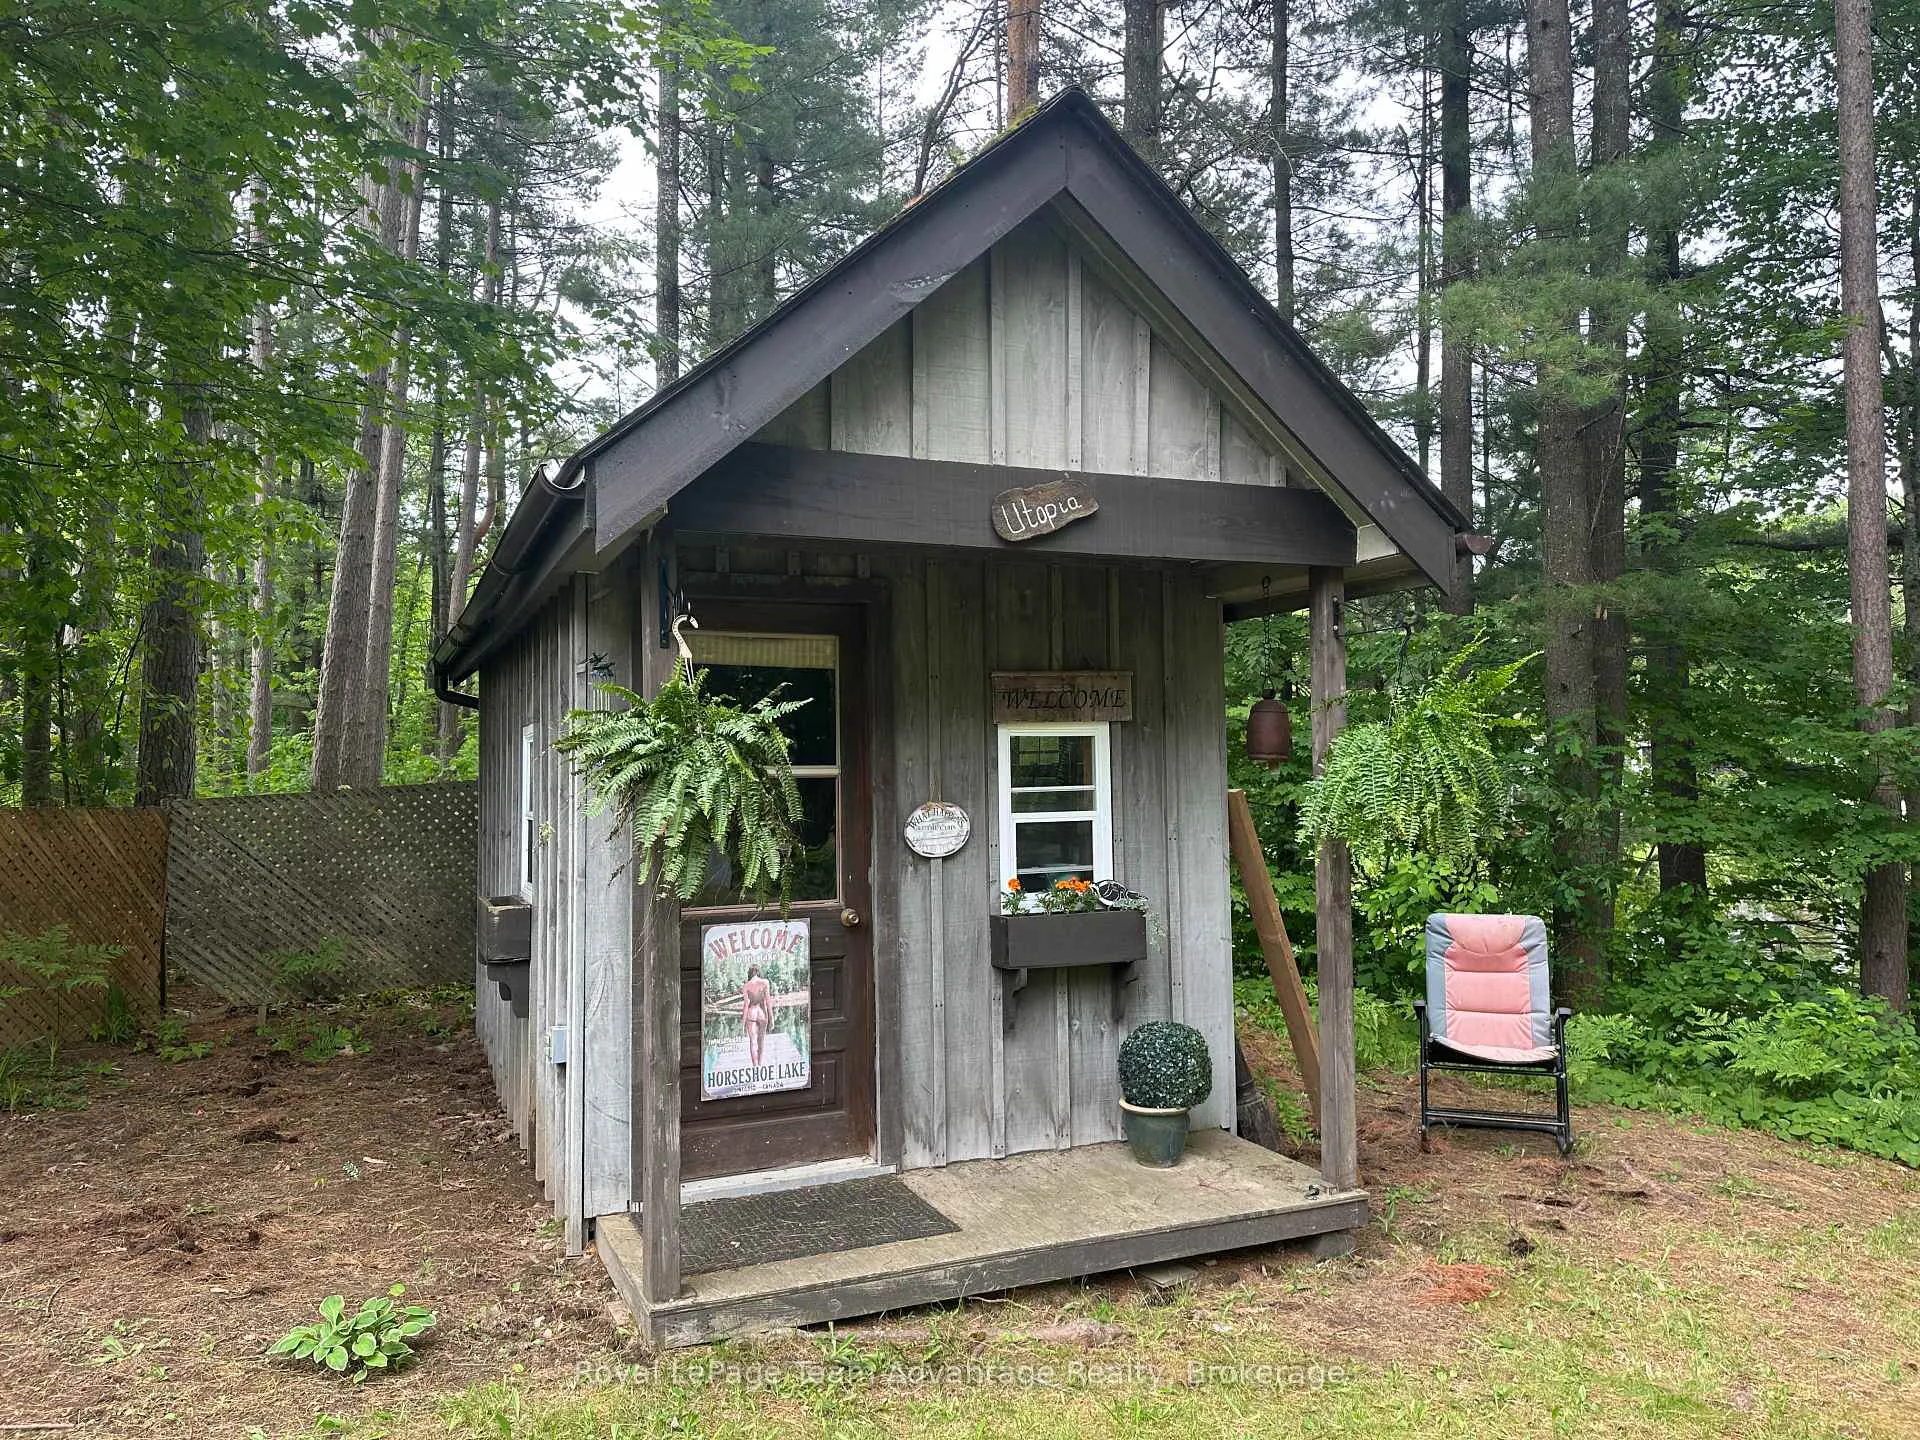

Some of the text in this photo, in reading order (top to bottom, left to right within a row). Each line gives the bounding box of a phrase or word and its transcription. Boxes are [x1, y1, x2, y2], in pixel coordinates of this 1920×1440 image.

[1001, 496, 1083, 534] Utopia
[998, 687, 1126, 709] WELCOME
[708, 927, 804, 960] WELCOME
[707, 1061, 806, 1088] HORSESHOE LAKE
